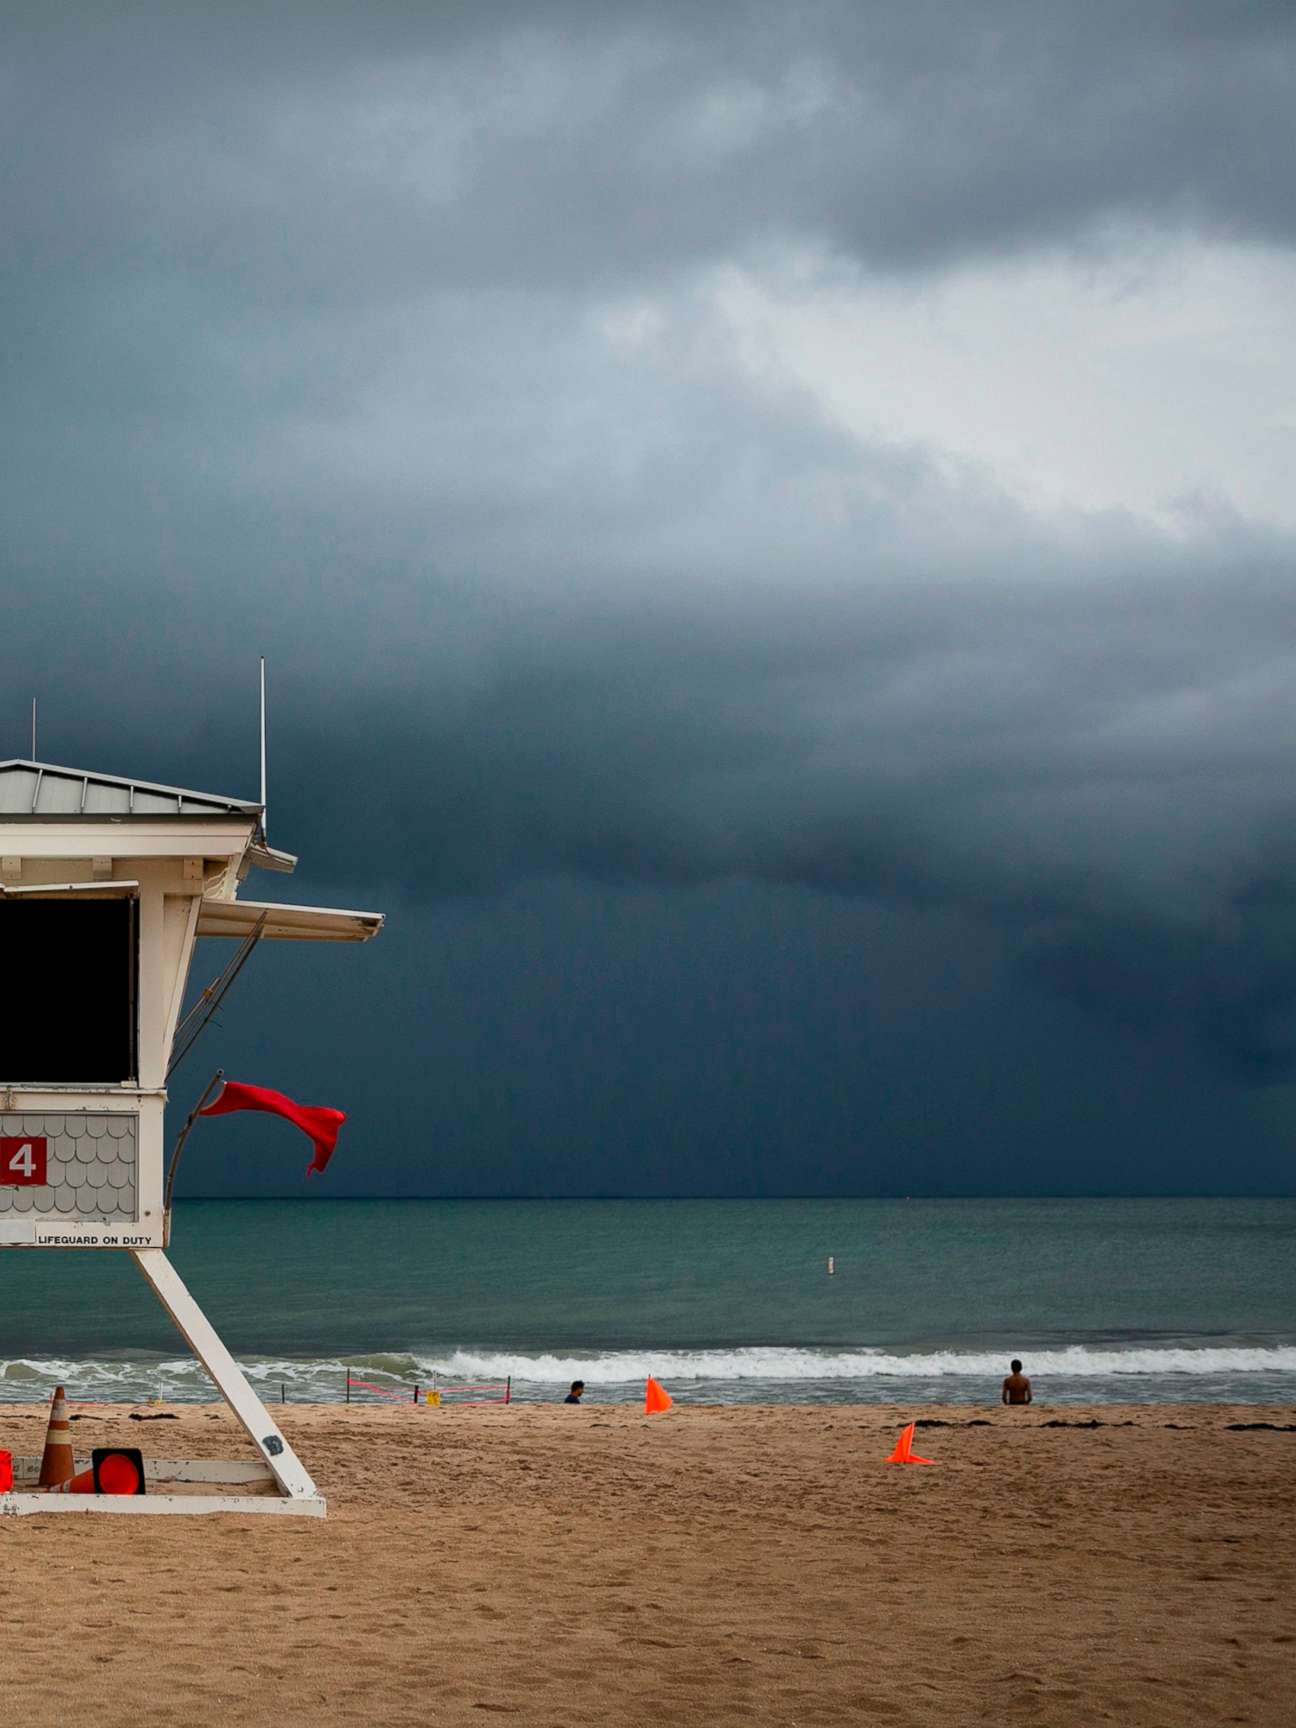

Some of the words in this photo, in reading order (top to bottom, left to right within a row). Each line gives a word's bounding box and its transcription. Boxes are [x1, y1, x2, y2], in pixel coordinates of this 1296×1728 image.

[9, 1143, 37, 1177] 4
[38, 1236, 98, 1245] LIFEGUARD
[103, 1236, 118, 1245] ON
[123, 1237, 152, 1245] DUTY
